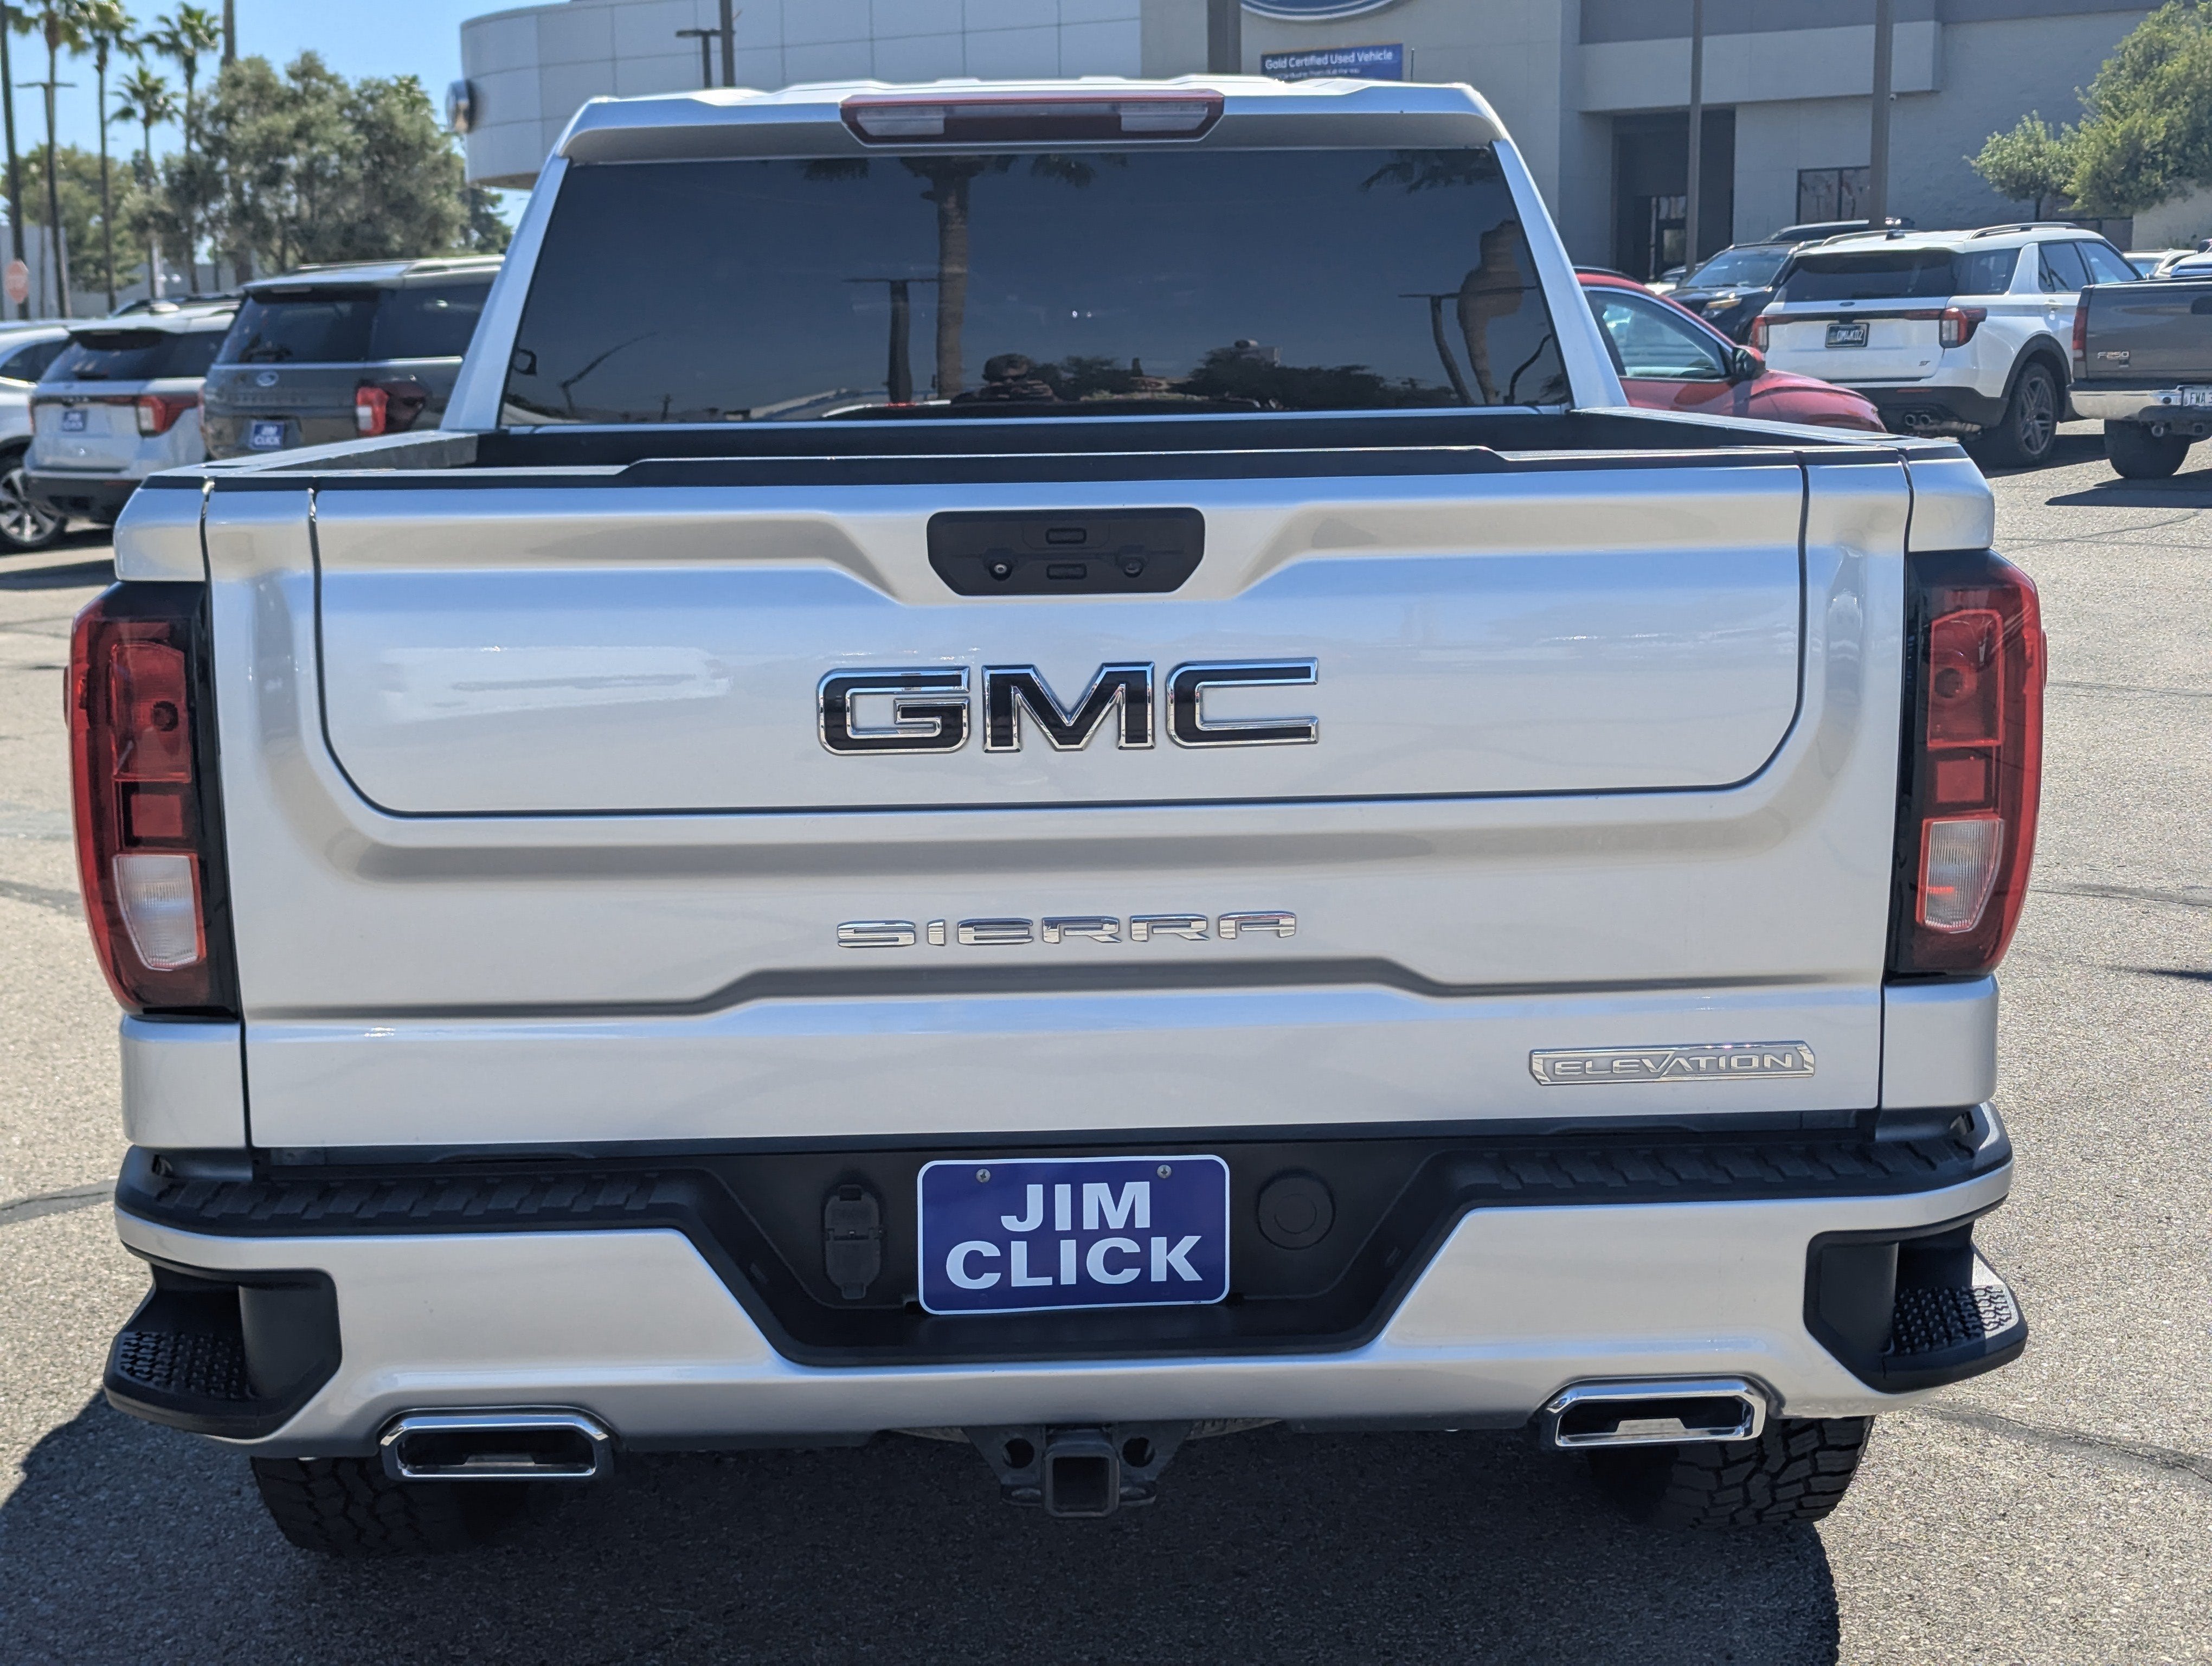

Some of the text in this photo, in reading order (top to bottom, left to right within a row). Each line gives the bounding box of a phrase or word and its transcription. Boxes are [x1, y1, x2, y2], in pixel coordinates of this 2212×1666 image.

[1265, 49, 1392, 70] Gold Certified Used Vehicle
[816, 657, 1319, 755] GMC
[837, 911, 1297, 948] SIERRA
[1554, 1053, 1791, 1076] ELEVATION
[1000, 1181, 1150, 1232] JIM
[945, 1235, 1203, 1290] CLICK
